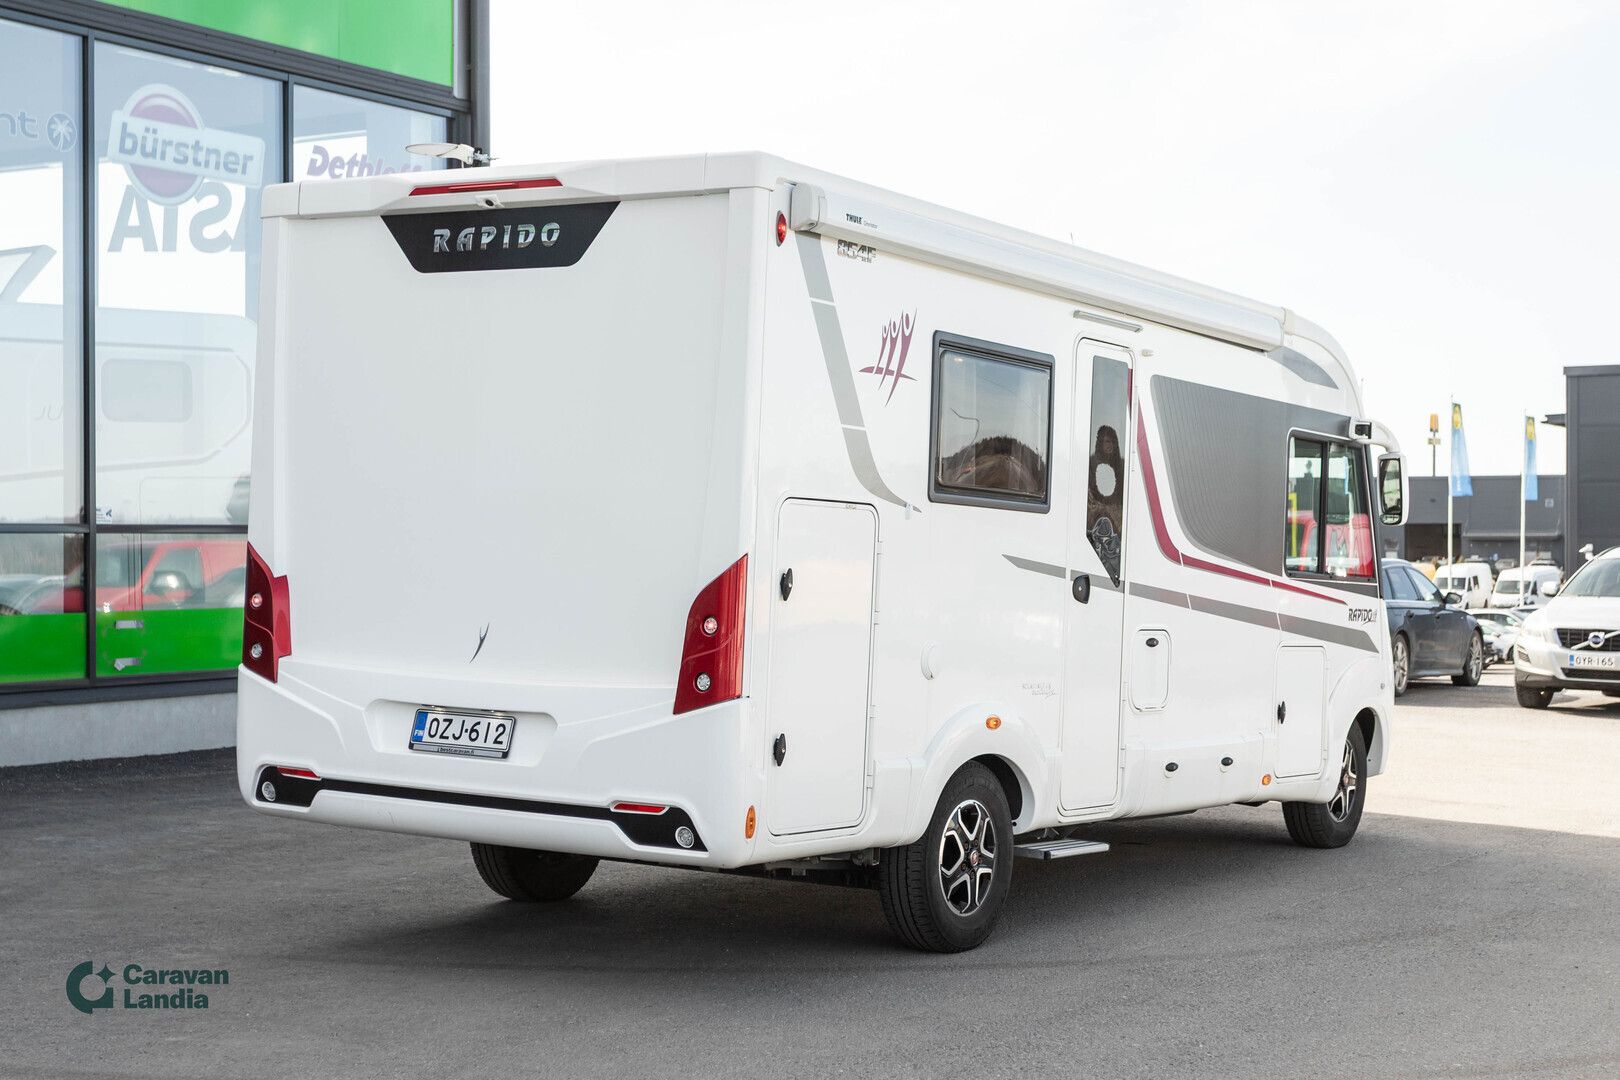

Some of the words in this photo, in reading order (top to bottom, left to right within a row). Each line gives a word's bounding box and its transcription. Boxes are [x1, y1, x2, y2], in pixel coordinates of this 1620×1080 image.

[118, 121, 255, 176] bürstner
[846, 213, 863, 225] THULE
[432, 222, 562, 253] RAPIDO
[1348, 607, 1373, 623] RAPIDO
[427, 716, 507, 745] OZJ-612
